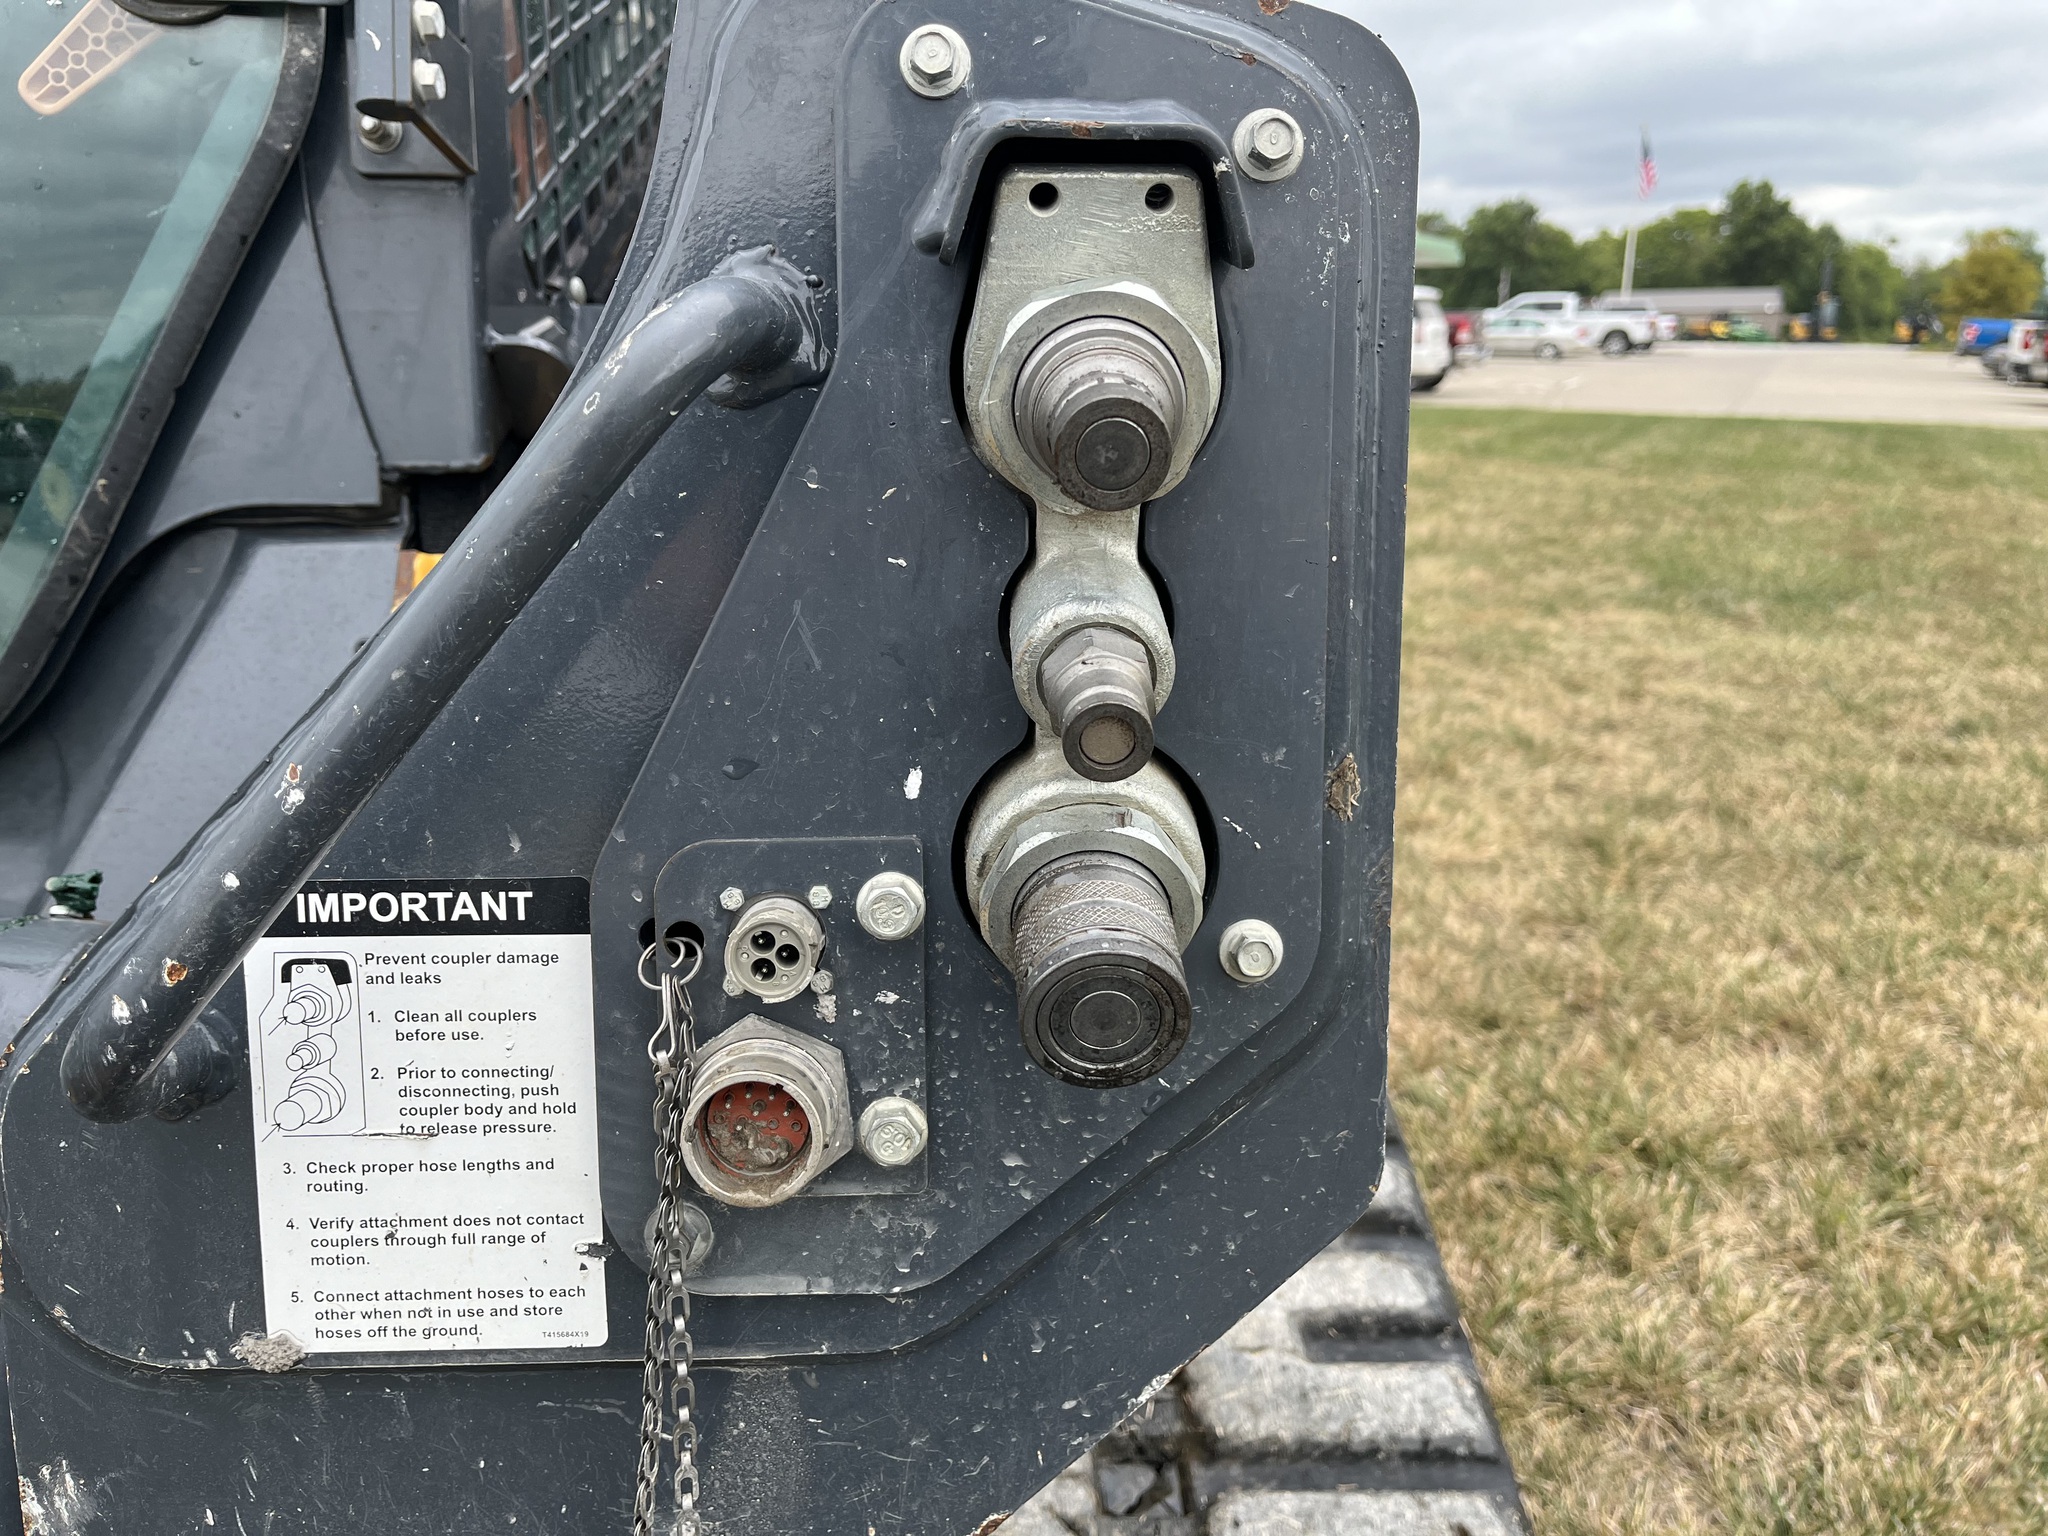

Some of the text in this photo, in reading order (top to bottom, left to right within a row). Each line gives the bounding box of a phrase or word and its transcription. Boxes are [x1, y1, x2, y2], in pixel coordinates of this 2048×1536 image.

[297, 891, 532, 923] IMPORTANT
[364, 951, 559, 968] Prevent coupler damage
[365, 971, 442, 985] and leaks
[367, 1008, 537, 1025] 1. Clean all couplers
[395, 1028, 484, 1042] before use.
[370, 1065, 555, 1081] 2. Prior to connecting/
[399, 1083, 559, 1100] disconnecting, push
[399, 1101, 577, 1119] coupler body and hold
[399, 1122, 557, 1137] to release pressure.
[283, 1157, 555, 1176] 3. Check proper hose lengths and
[307, 1179, 368, 1195] routing.
[285, 1213, 585, 1232] 4. Verify attachment does not contact
[310, 1230, 547, 1251] couplers through full range of
[311, 1254, 370, 1266] motion.
[291, 1285, 586, 1303] 5. Connect attachment hoses to each
[314, 1304, 563, 1321] other when not in use and store
[315, 1324, 483, 1339] hoses off the ground.
